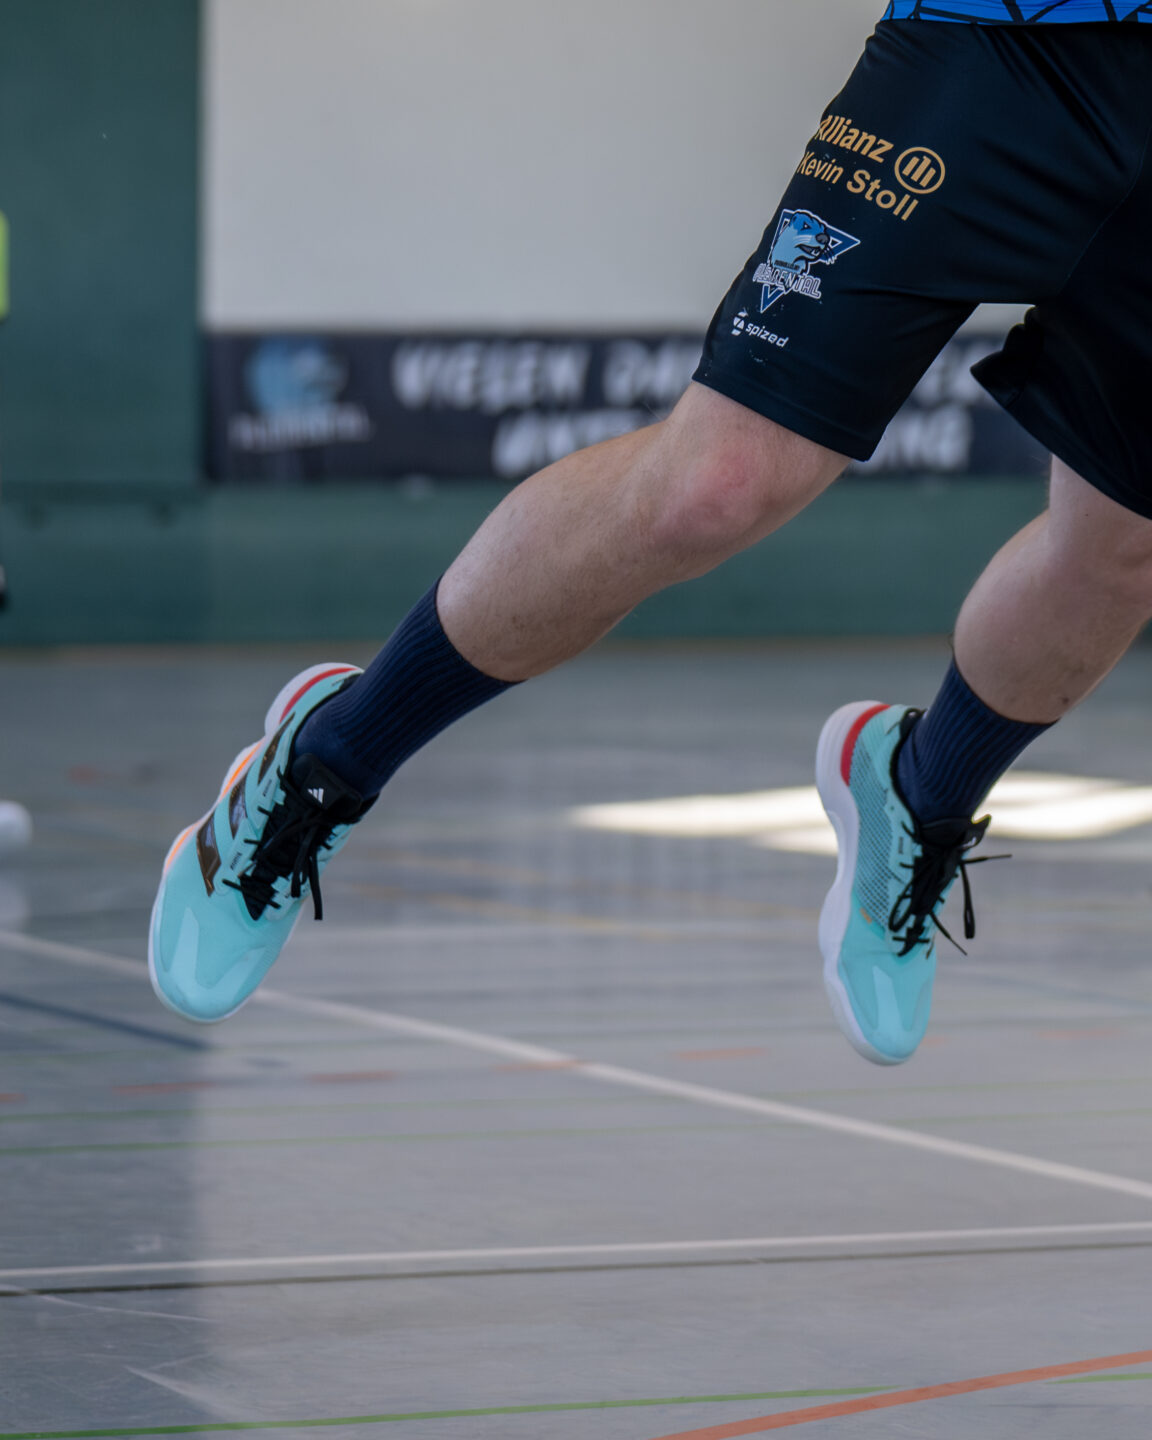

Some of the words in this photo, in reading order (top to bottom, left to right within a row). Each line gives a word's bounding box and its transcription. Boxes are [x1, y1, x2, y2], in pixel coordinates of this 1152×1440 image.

[814, 114, 895, 164] Allianz
[845, 168, 920, 222] Stoll
[745, 322, 790, 348] spized
